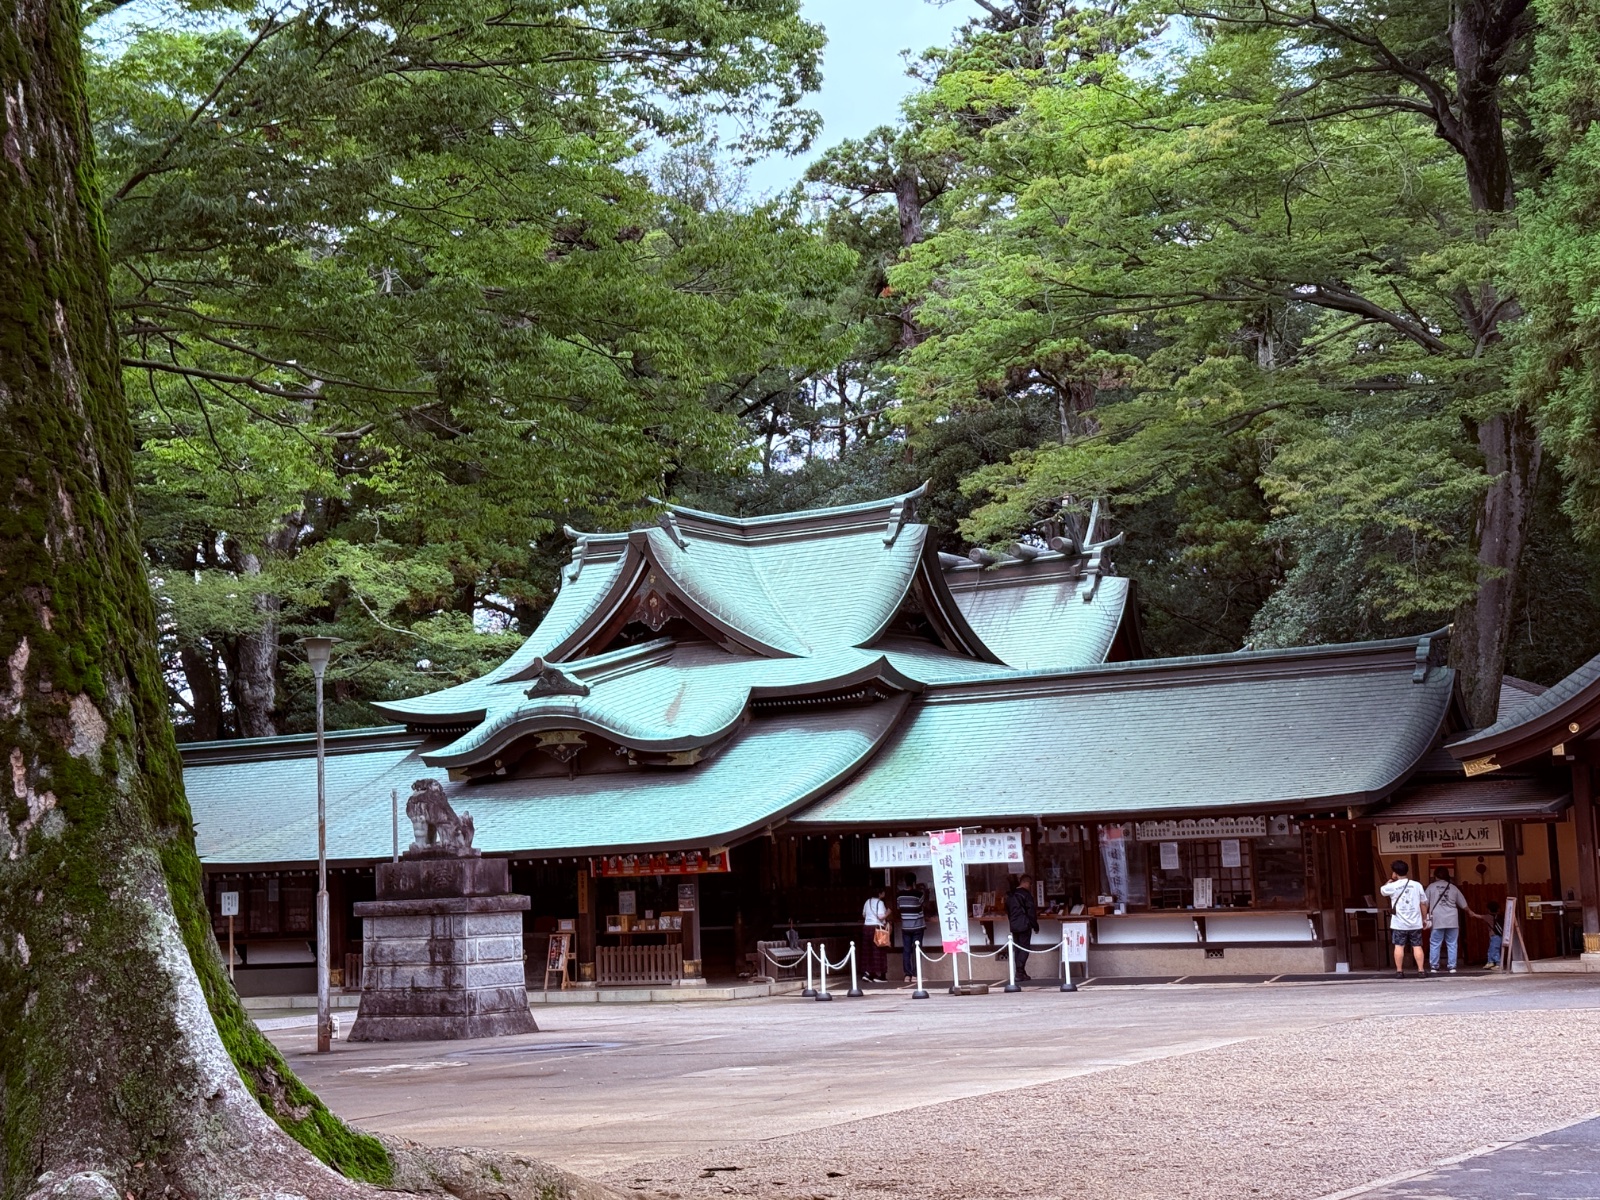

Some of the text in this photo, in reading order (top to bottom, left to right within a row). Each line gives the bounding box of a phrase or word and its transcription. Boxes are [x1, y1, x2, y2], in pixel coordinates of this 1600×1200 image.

[1388, 827, 1490, 843] 御祈祷申込記入所
